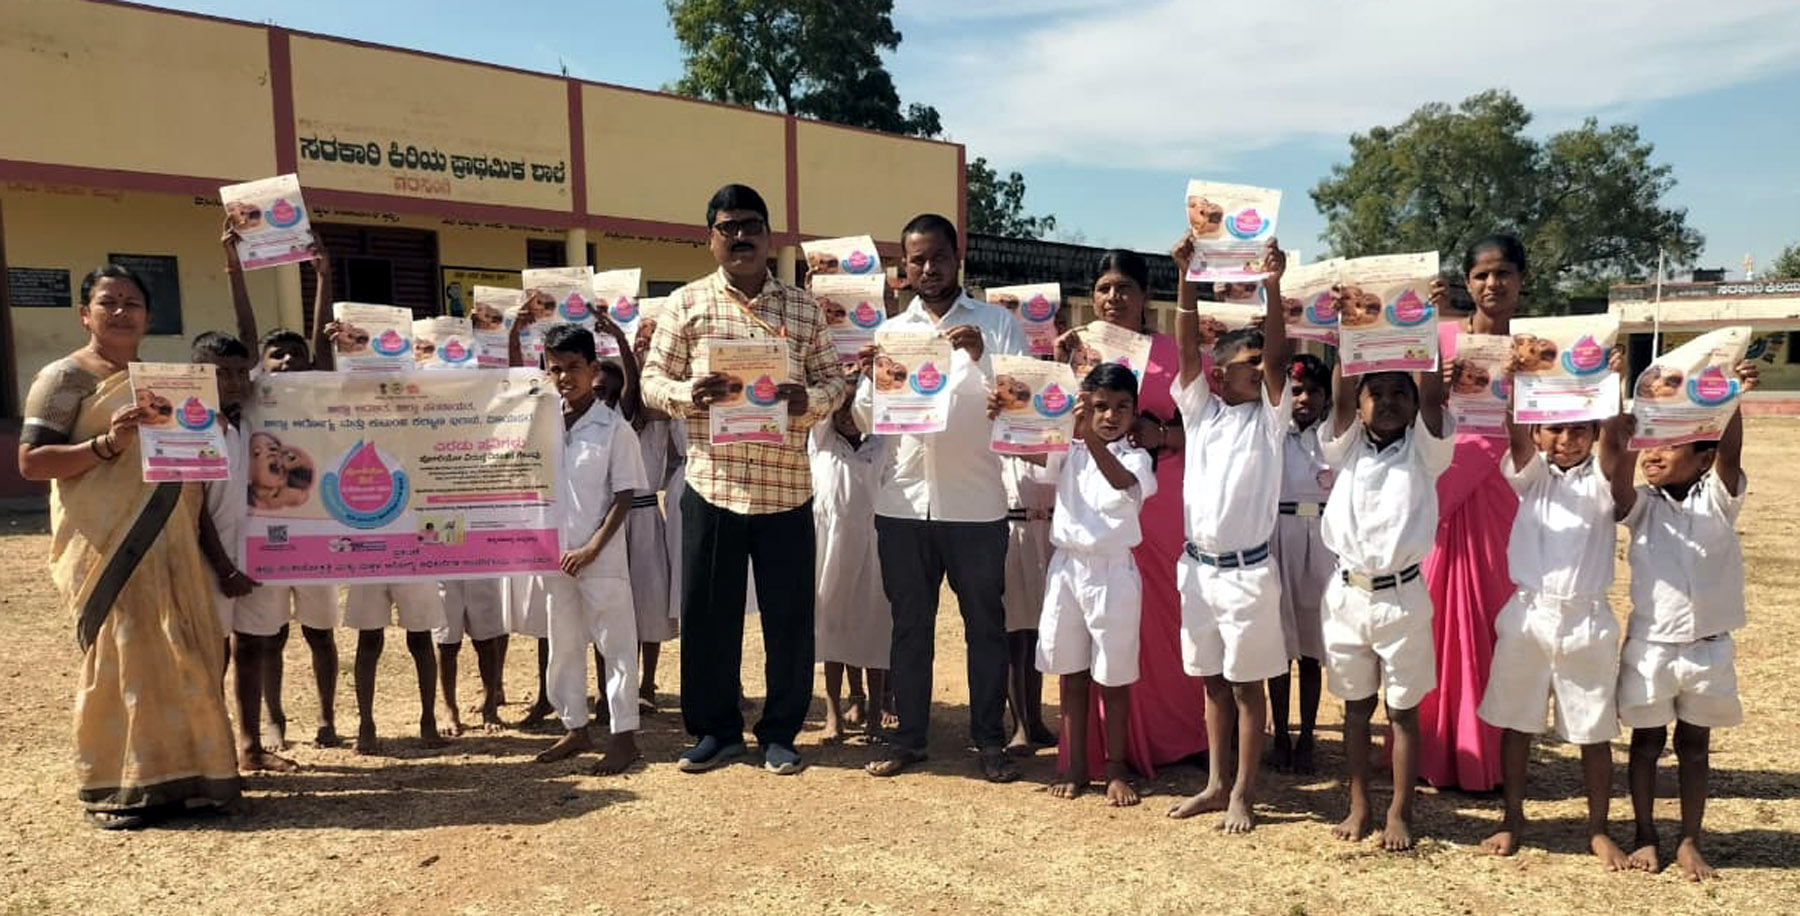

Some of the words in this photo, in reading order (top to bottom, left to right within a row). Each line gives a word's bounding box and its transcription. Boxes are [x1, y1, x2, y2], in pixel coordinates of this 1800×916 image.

[299, 134, 381, 166] ಸರಕಾರಿ
[387, 141, 447, 172] ಕಿರಿಯ
[450, 154, 526, 181] ಪ್ರಾಥಮಿಕ
[531, 161, 566, 184] ಶಾಲೆ
[1717, 283, 1763, 295] ಸರಕಾರಿ
